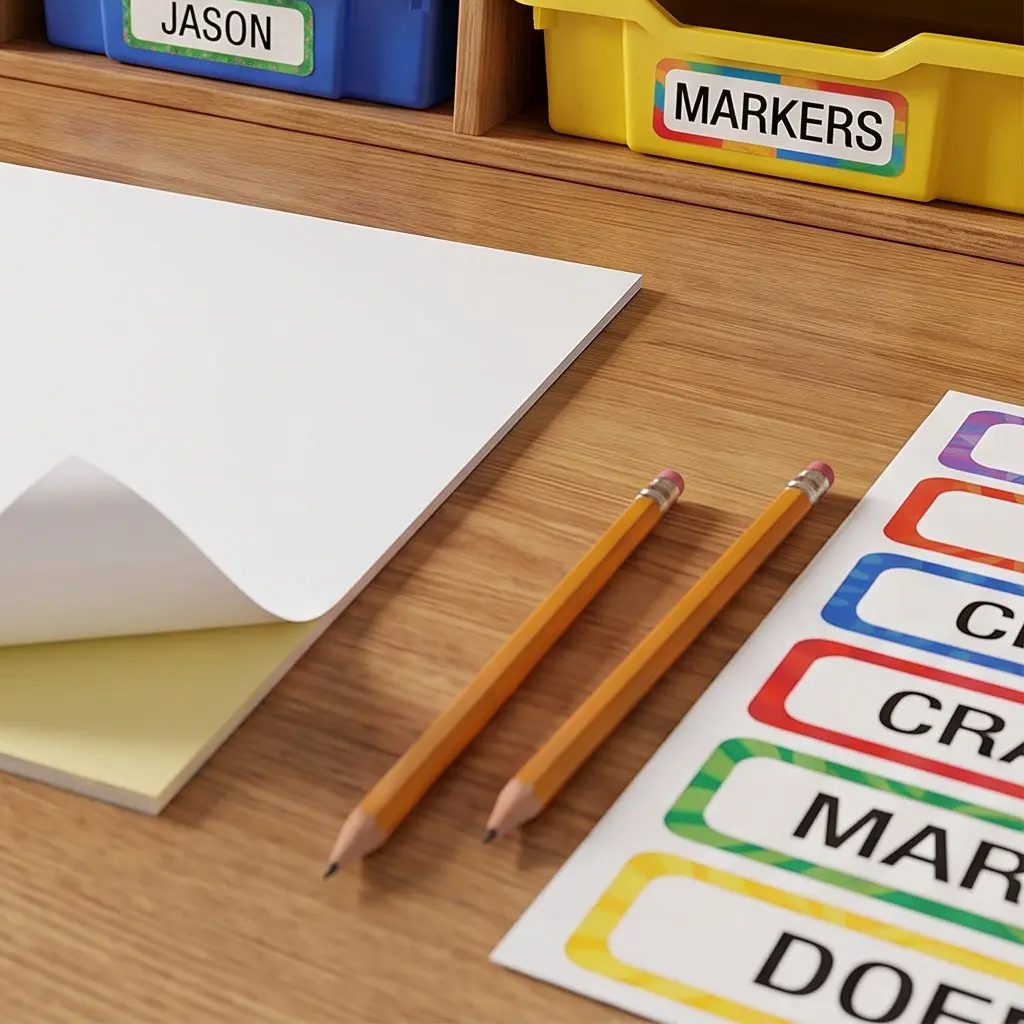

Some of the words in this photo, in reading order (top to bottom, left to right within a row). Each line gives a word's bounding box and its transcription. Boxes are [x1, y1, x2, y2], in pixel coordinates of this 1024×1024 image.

[161, 1, 272, 51] JASON
[674, 81, 883, 152] MARKERS
[955, 600, 1024, 649] C
[792, 792, 1024, 905] MAR
